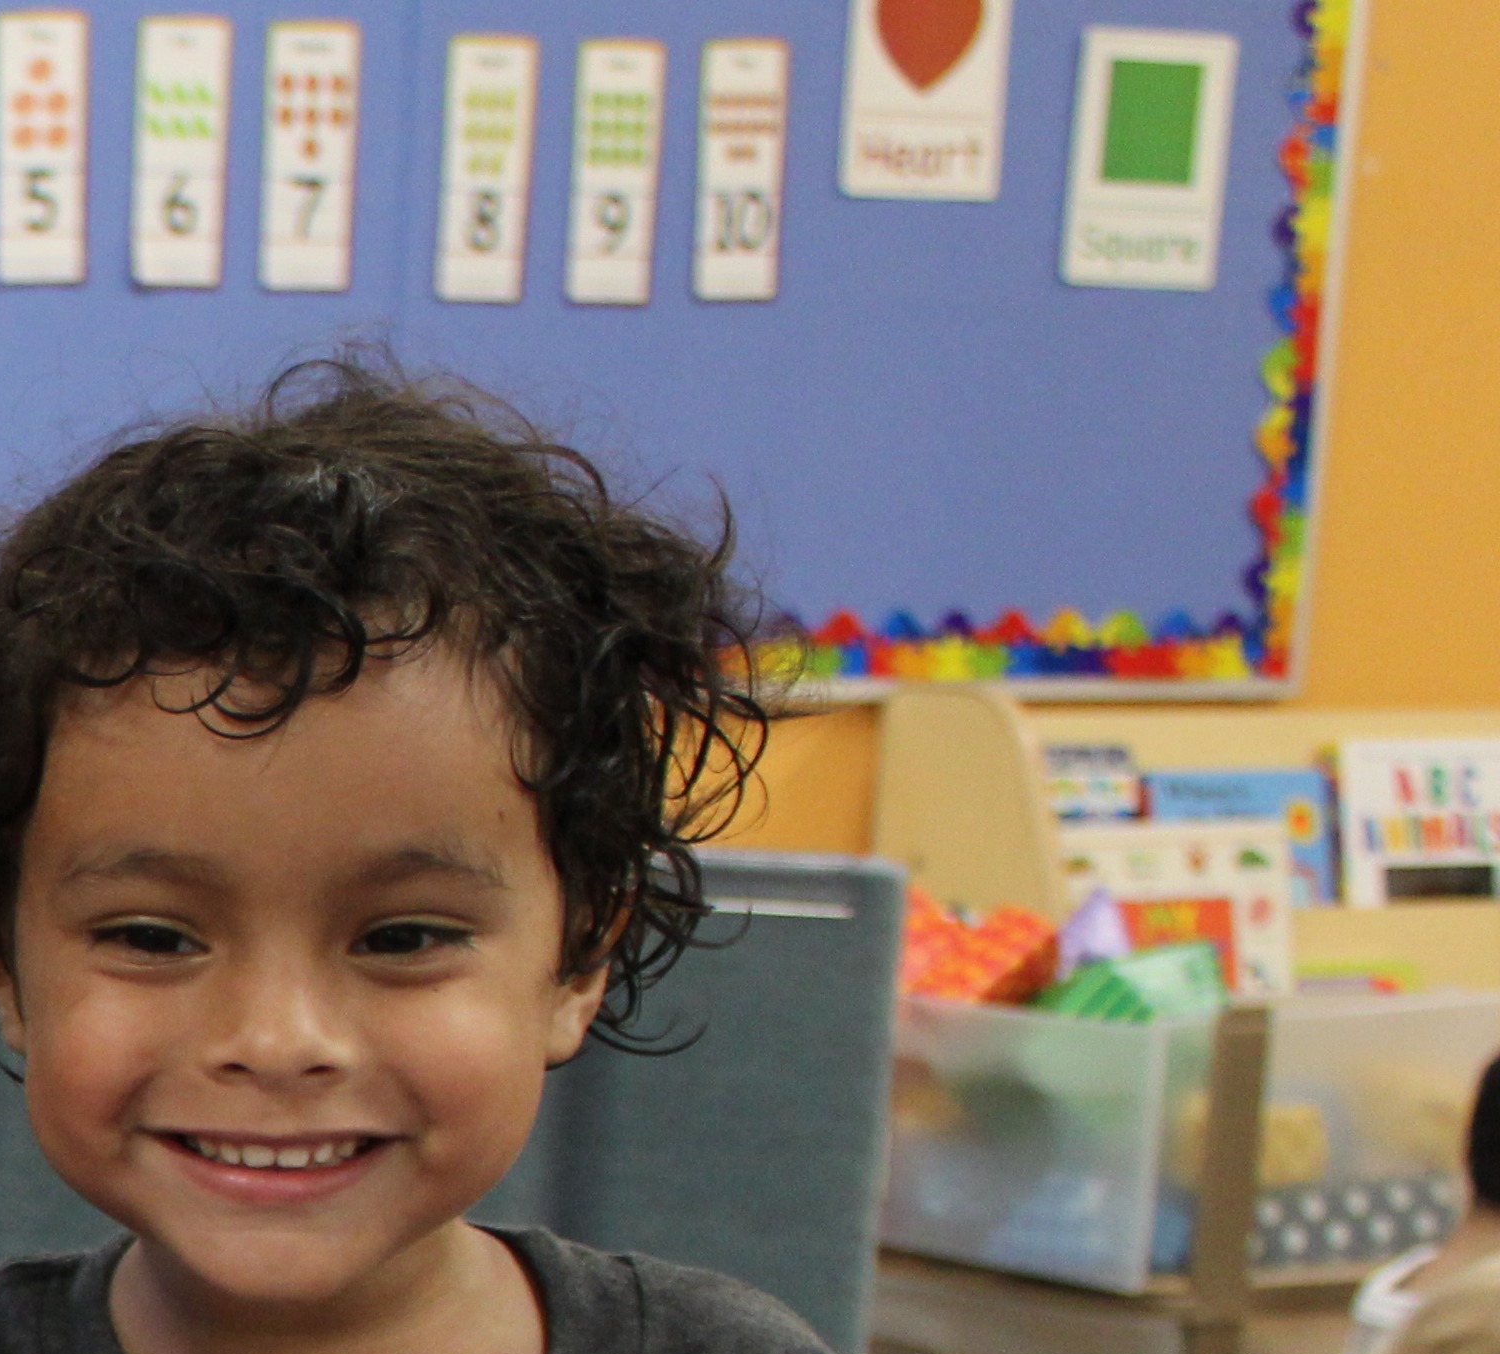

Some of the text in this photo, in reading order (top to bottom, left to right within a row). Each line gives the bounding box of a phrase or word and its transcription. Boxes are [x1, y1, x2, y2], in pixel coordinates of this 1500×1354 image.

[859, 130, 981, 178] Heart
[19, 168, 58, 234] 5
[163, 172, 198, 236] 6
[290, 174, 326, 241] 7
[466, 189, 500, 253] 8
[593, 192, 630, 256] 9
[713, 188, 772, 252] 10
[1077, 220, 1200, 272] Square
[1393, 765, 1482, 806] ABC
